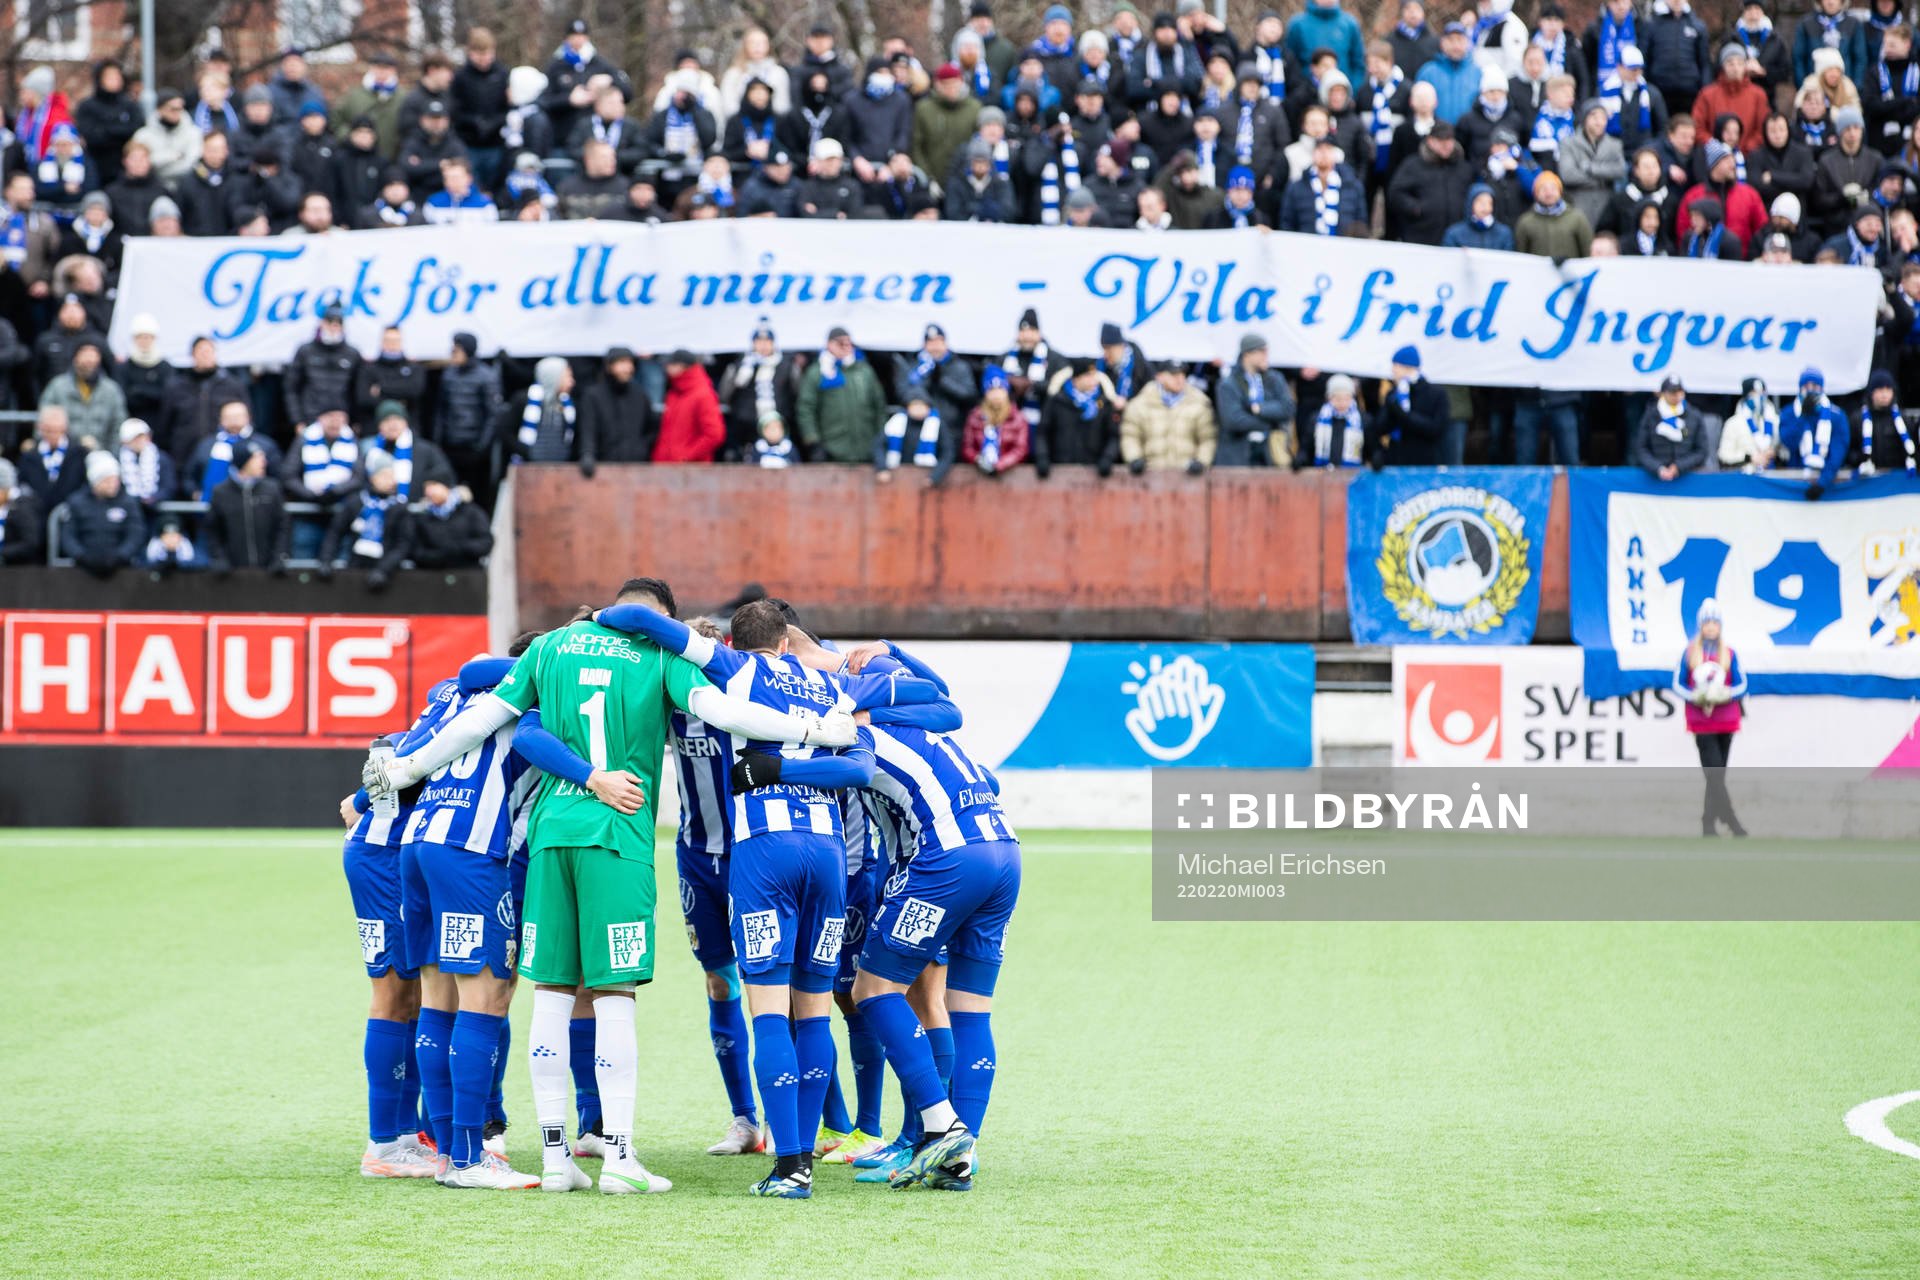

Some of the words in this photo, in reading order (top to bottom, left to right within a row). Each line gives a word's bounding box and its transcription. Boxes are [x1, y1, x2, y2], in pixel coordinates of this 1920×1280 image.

[203, 245, 381, 341] Tack
[395, 256, 497, 327] för
[520, 243, 658, 310] alla
[681, 252, 955, 307] minnen
[1083, 253, 1278, 330] Vila
[1300, 272, 1333, 326] i
[1338, 269, 1511, 343] frid
[1520, 268, 1819, 374] Ingvar
[1626, 535, 1648, 644] ANNO
[569, 633, 632, 648] NORDIC
[556, 643, 643, 664] WELLNESS
[20, 633, 398, 720] HAUS
[774, 671, 828, 695] NORDIC
[763, 675, 836, 708] WELLNESS
[1523, 728, 1639, 763] SPEL
[906, 900, 938, 919] EFF
[446, 916, 476, 930] EFF
[745, 914, 770, 930] EFF
[902, 911, 936, 932] EKT
[445, 928, 479, 943] EKT
[611, 925, 638, 940] EFF
[747, 926, 776, 943] EKT
[895, 922, 916, 938] IV
[444, 941, 462, 954] IV
[613, 938, 643, 953] EKT
[749, 941, 762, 955] IV
[817, 945, 834, 959] IV
[614, 952, 631, 966] IV
